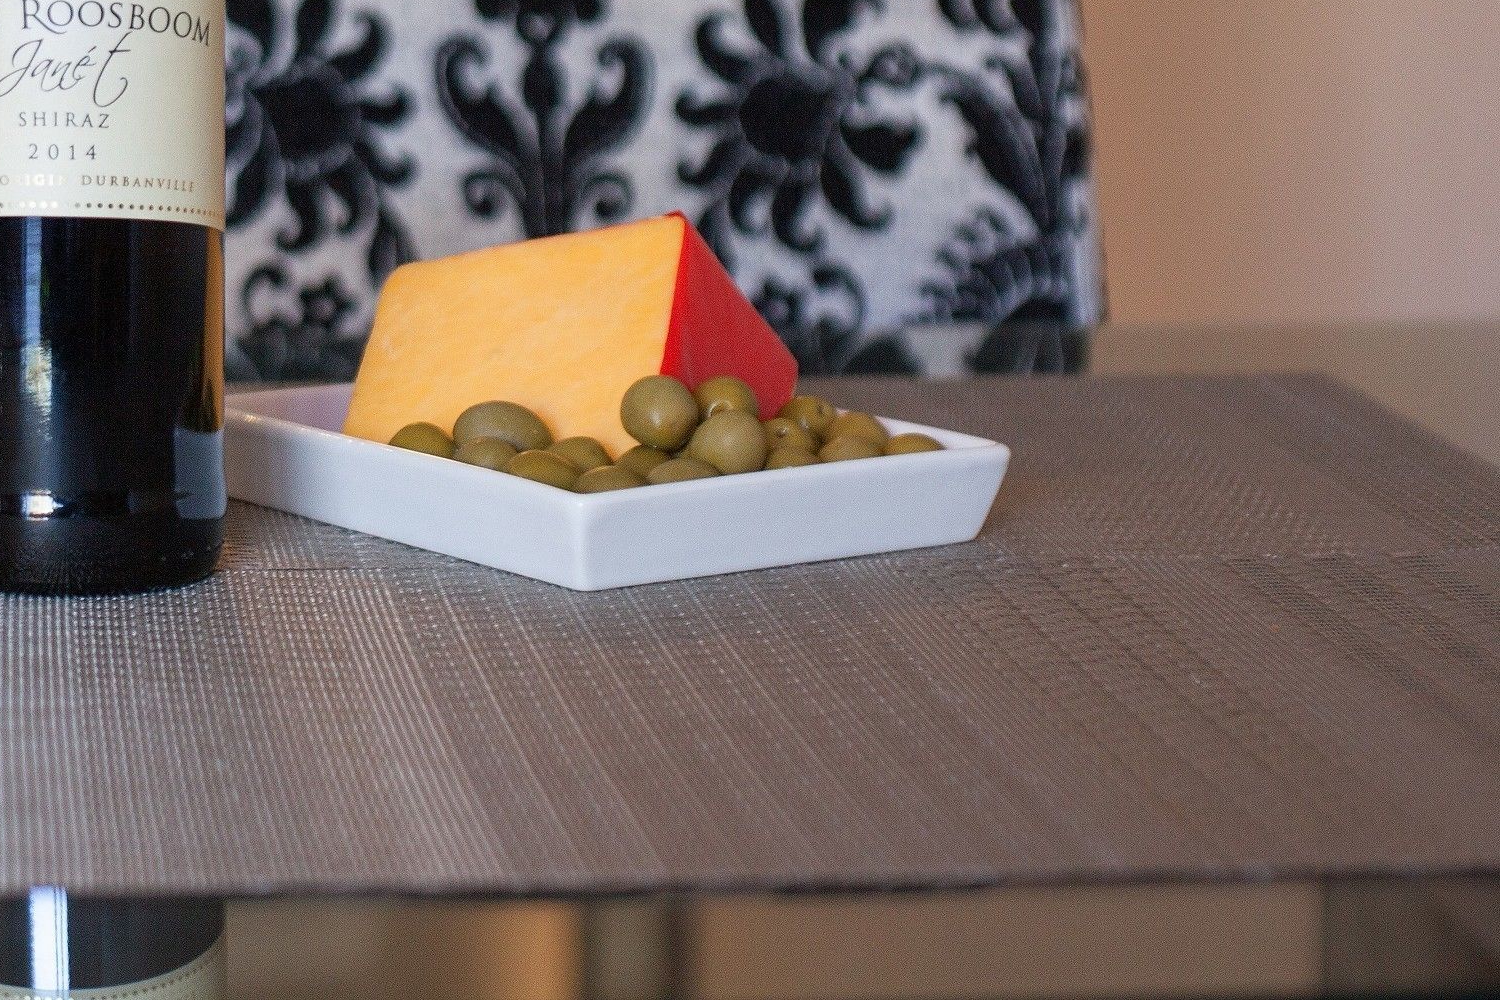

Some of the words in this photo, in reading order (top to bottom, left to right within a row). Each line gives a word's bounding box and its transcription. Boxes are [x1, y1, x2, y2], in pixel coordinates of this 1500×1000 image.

[19, 111, 110, 129] SHIRAZ
[28, 143, 96, 160] 2014
[81, 174, 196, 193] DURBANVILLE
